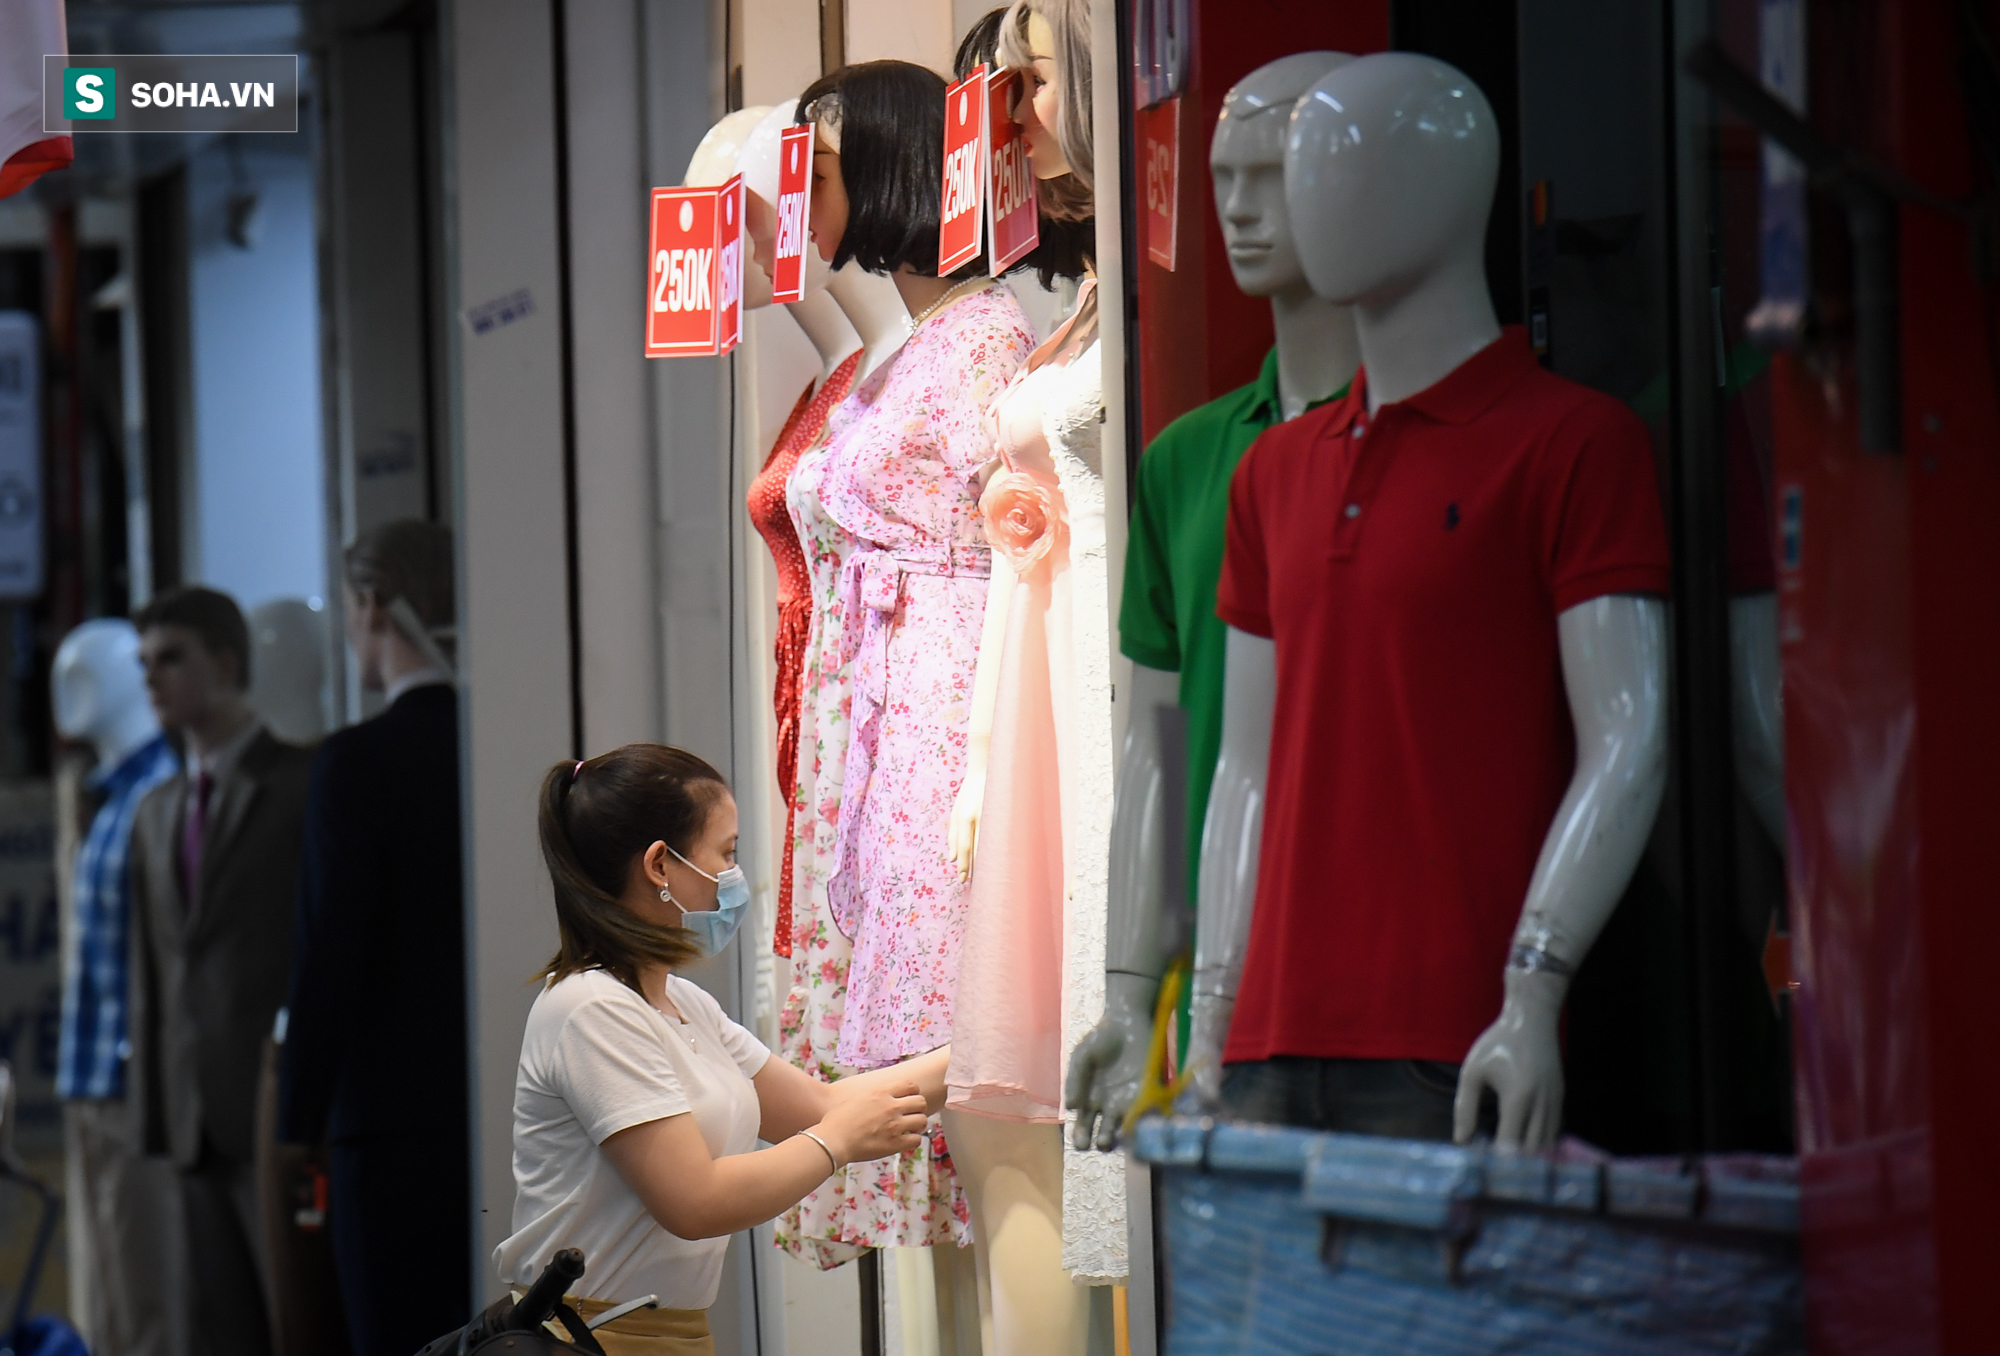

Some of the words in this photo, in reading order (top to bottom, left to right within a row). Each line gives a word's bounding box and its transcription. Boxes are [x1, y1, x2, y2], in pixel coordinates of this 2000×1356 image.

[944, 137, 979, 225] 250K
[994, 137, 1033, 222] 250K
[776, 191, 805, 259] 250K
[654, 247, 713, 313] 250K
